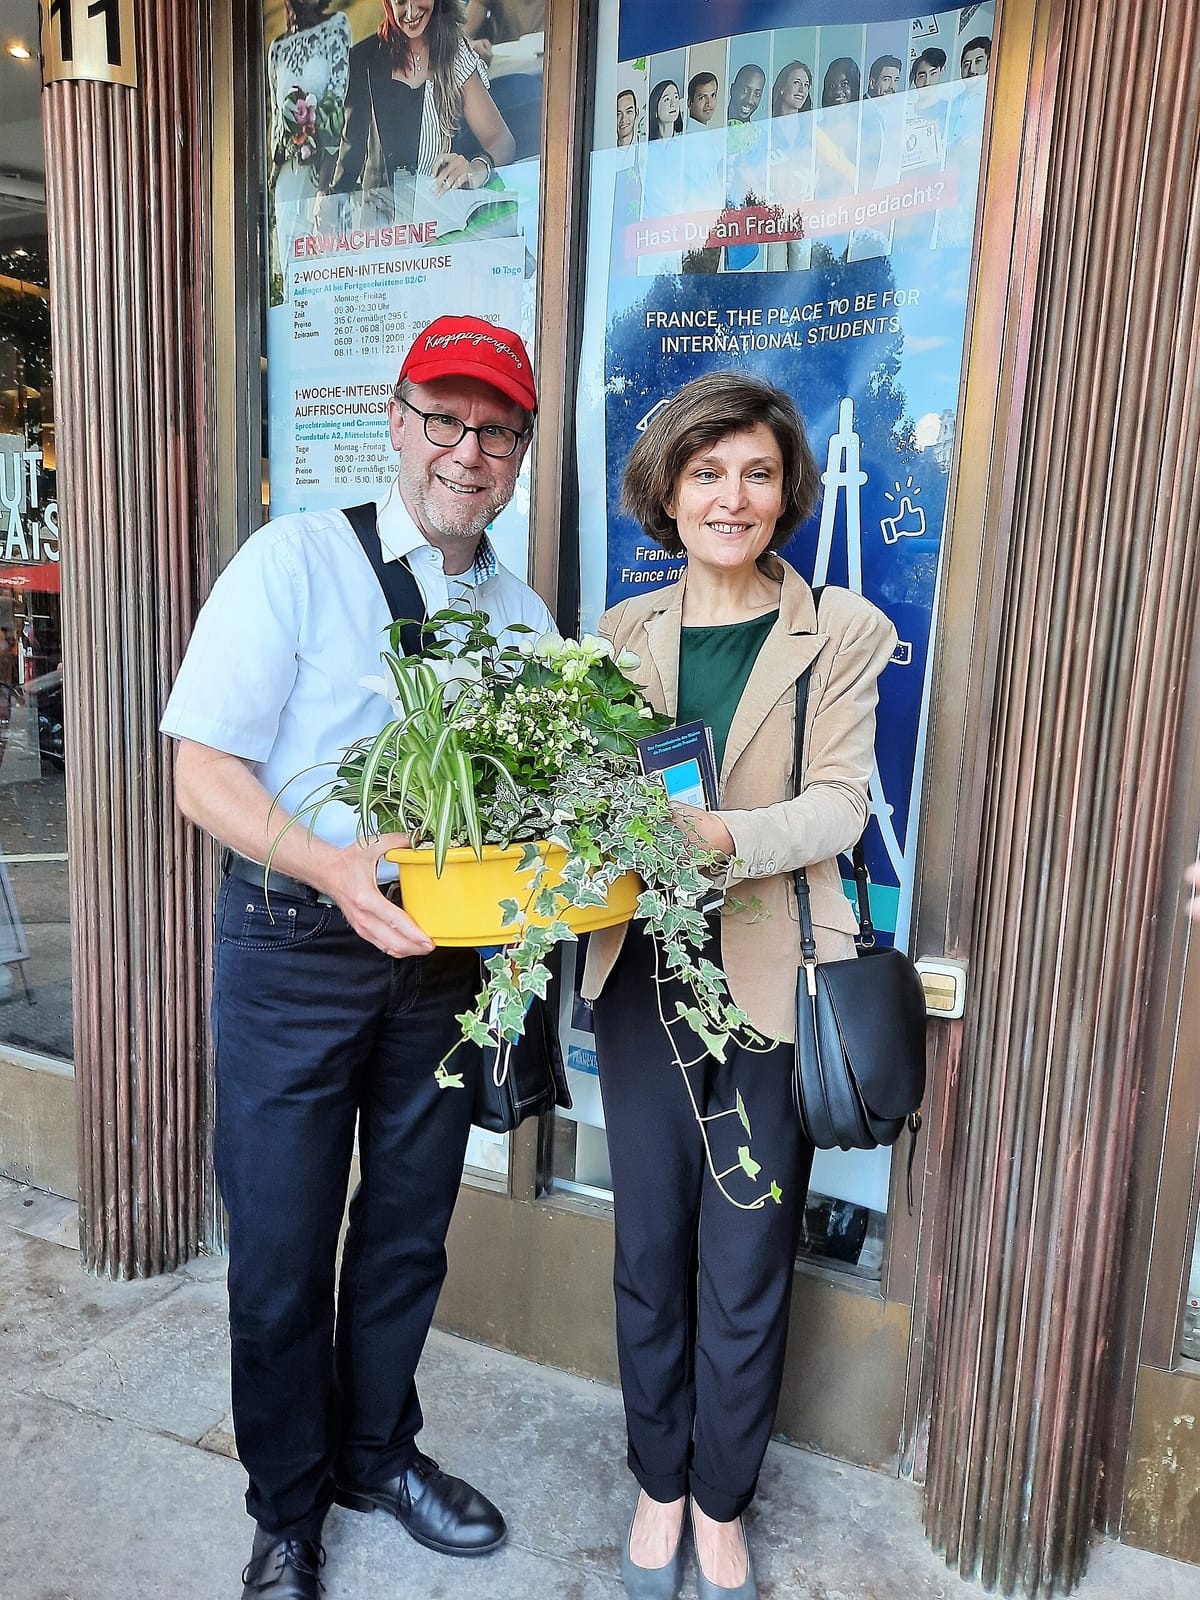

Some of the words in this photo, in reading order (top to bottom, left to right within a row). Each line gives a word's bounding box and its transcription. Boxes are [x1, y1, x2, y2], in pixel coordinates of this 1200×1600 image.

[51, 0, 121, 66] 11
[636, 225, 678, 249] Hast
[685, 222, 710, 241] Du
[716, 221, 739, 238] an
[745, 207, 848, 236] Frankreich
[854, 182, 945, 225] gedacht?
[294, 221, 437, 257] ERWACHSENE
[294, 255, 452, 284] 2-WOCHEN-INTENSIVKURSE
[334, 295, 359, 303] Montag
[363, 291, 387, 301] Freitag
[294, 311, 305, 319] Zeit
[377, 302, 390, 311] Uhr
[646, 310, 723, 329] FRANCE,
[726, 309, 762, 327] THE
[767, 303, 823, 325] PLACE
[828, 298, 849, 317] TO
[854, 293, 877, 312] BE
[882, 289, 920, 308] FOR
[661, 330, 803, 353] INTERNATIONAL
[807, 316, 900, 344] STUDENTS
[342, 419, 355, 428] und
[295, 445, 309, 454] Tage
[334, 443, 359, 452] Montag
[363, 442, 386, 452] Freitag
[295, 457, 306, 465] Zeit
[377, 453, 389, 462] Uhr
[295, 477, 320, 485] Zeitraum
[0, 502, 60, 561] AIS
[621, 568, 664, 583] France
